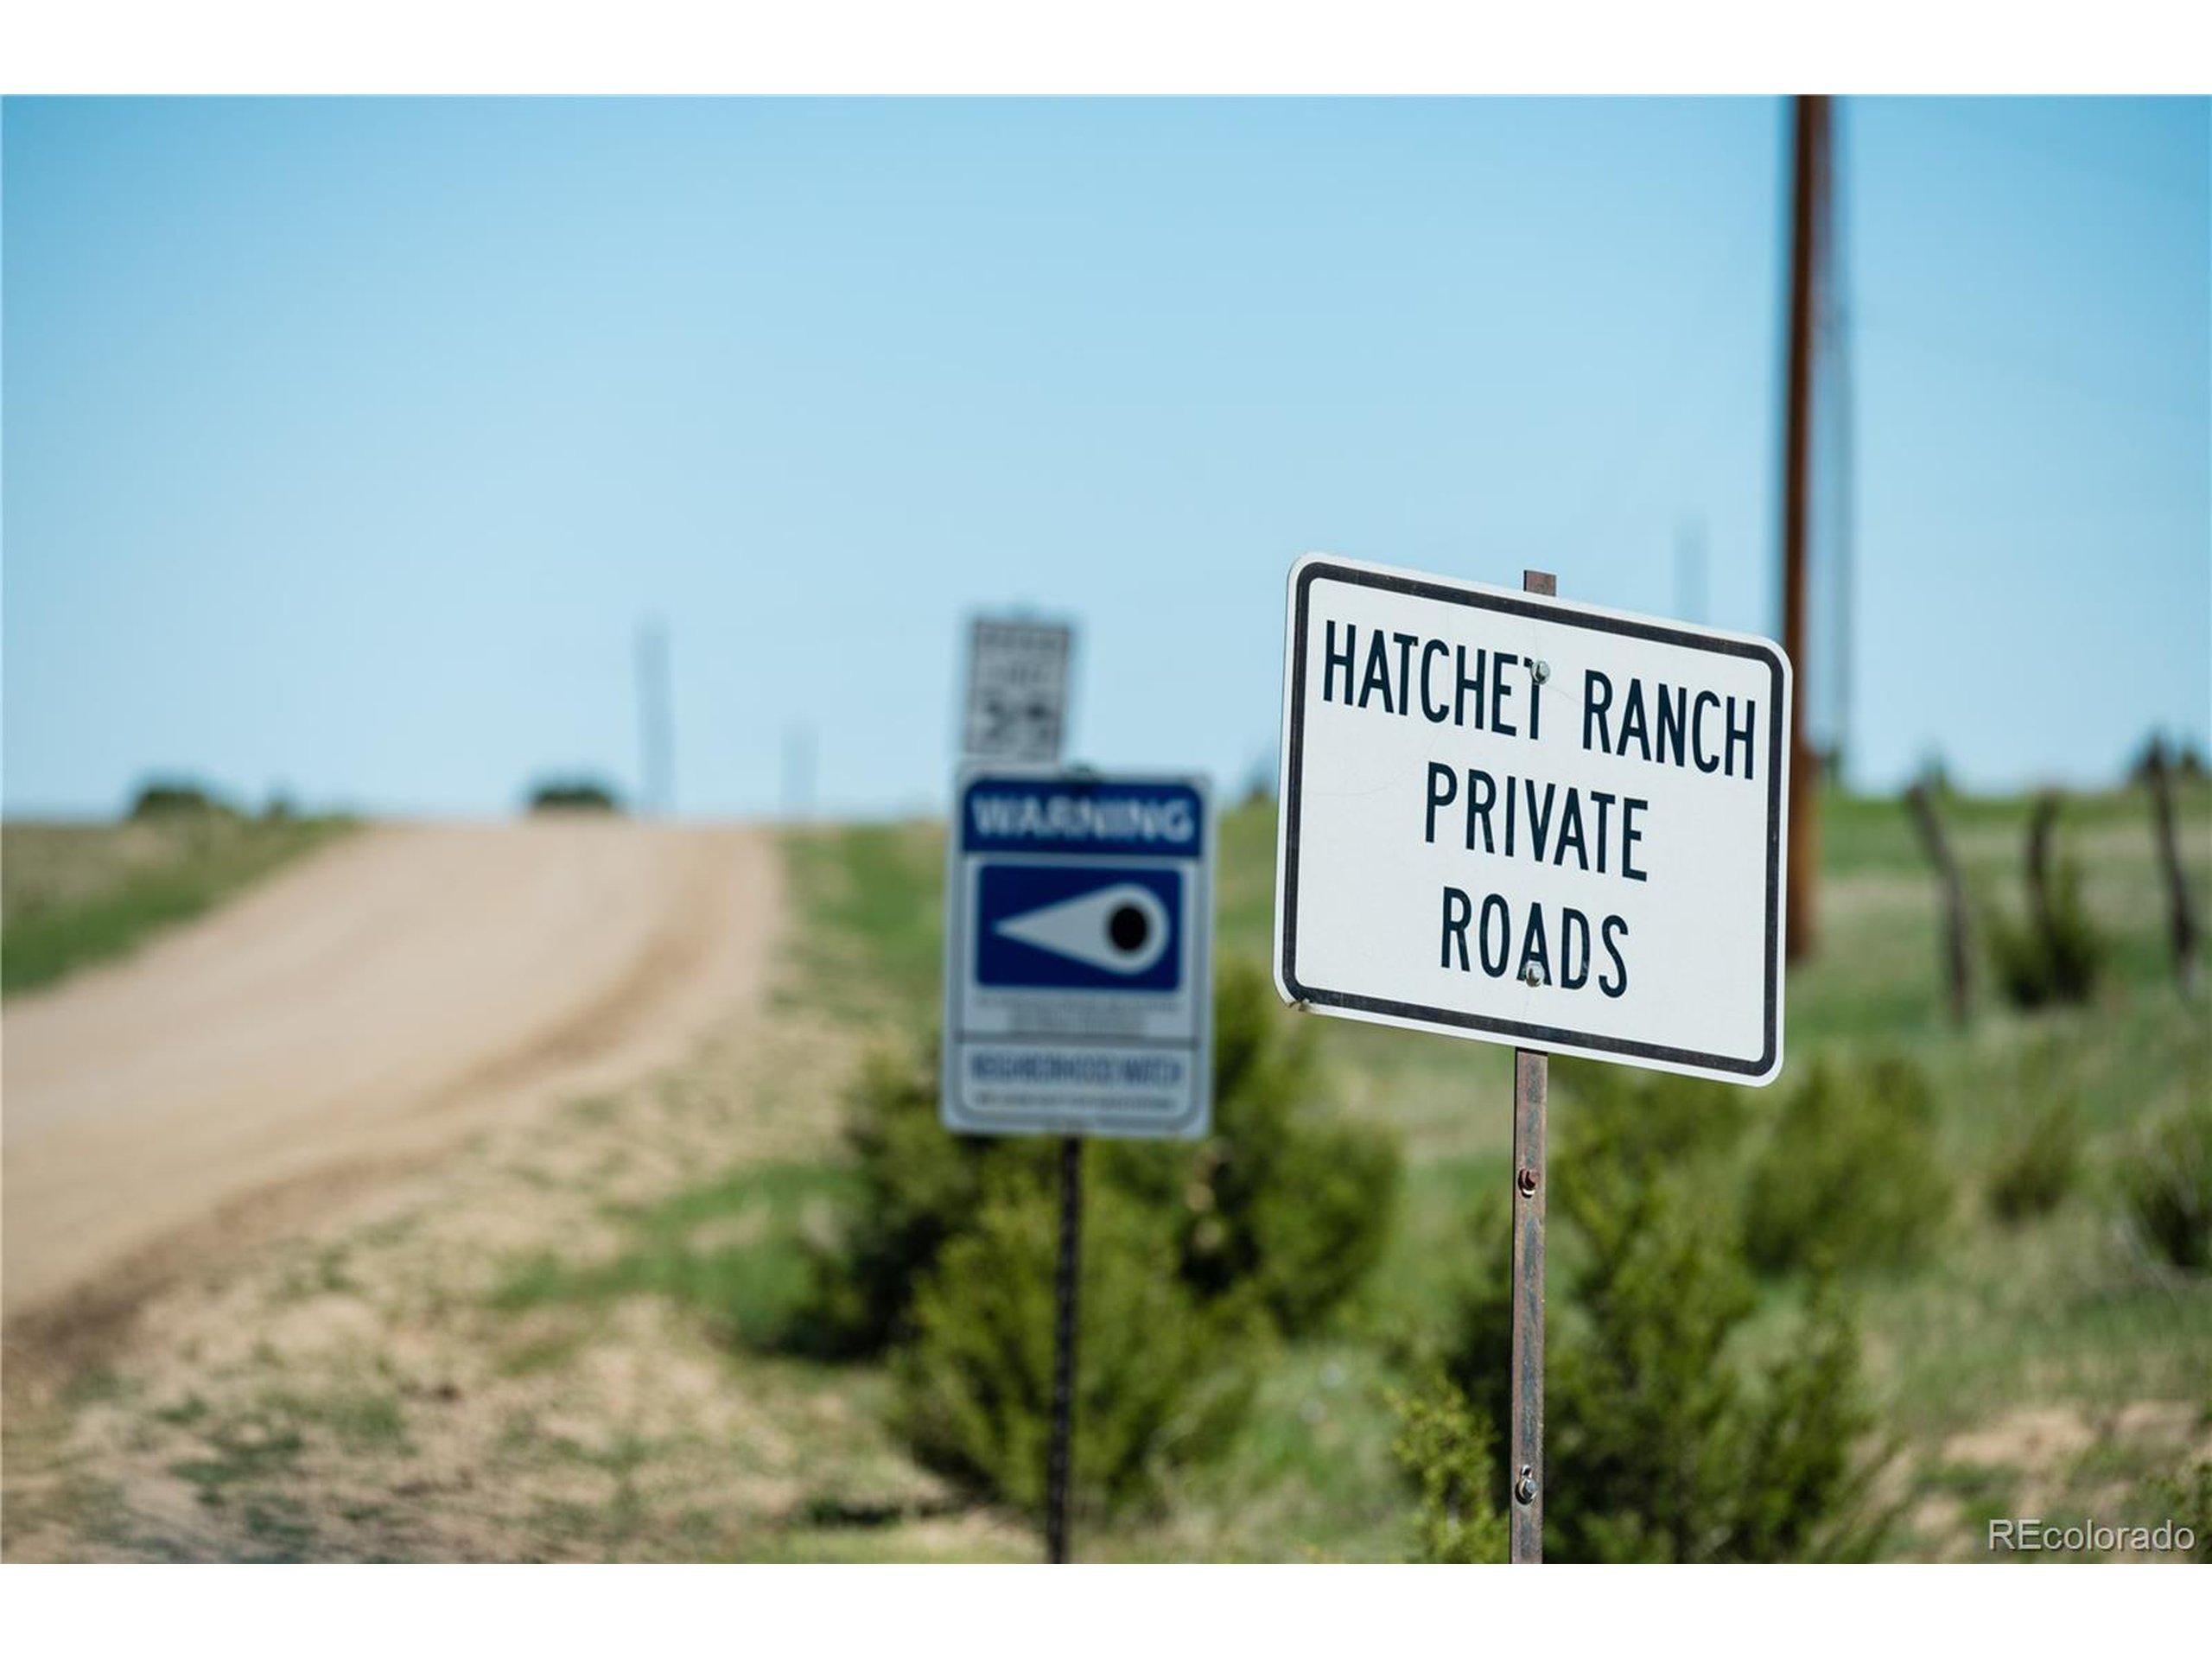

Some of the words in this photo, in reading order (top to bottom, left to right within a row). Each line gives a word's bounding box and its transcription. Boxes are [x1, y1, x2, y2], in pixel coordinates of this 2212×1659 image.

[1324, 620, 1547, 741] HATCHET
[1582, 669, 1757, 780] RANCH
[971, 796, 1195, 844] WARNING
[1425, 761, 1649, 882] PRIVATE
[1440, 887, 1630, 999] ROADS
